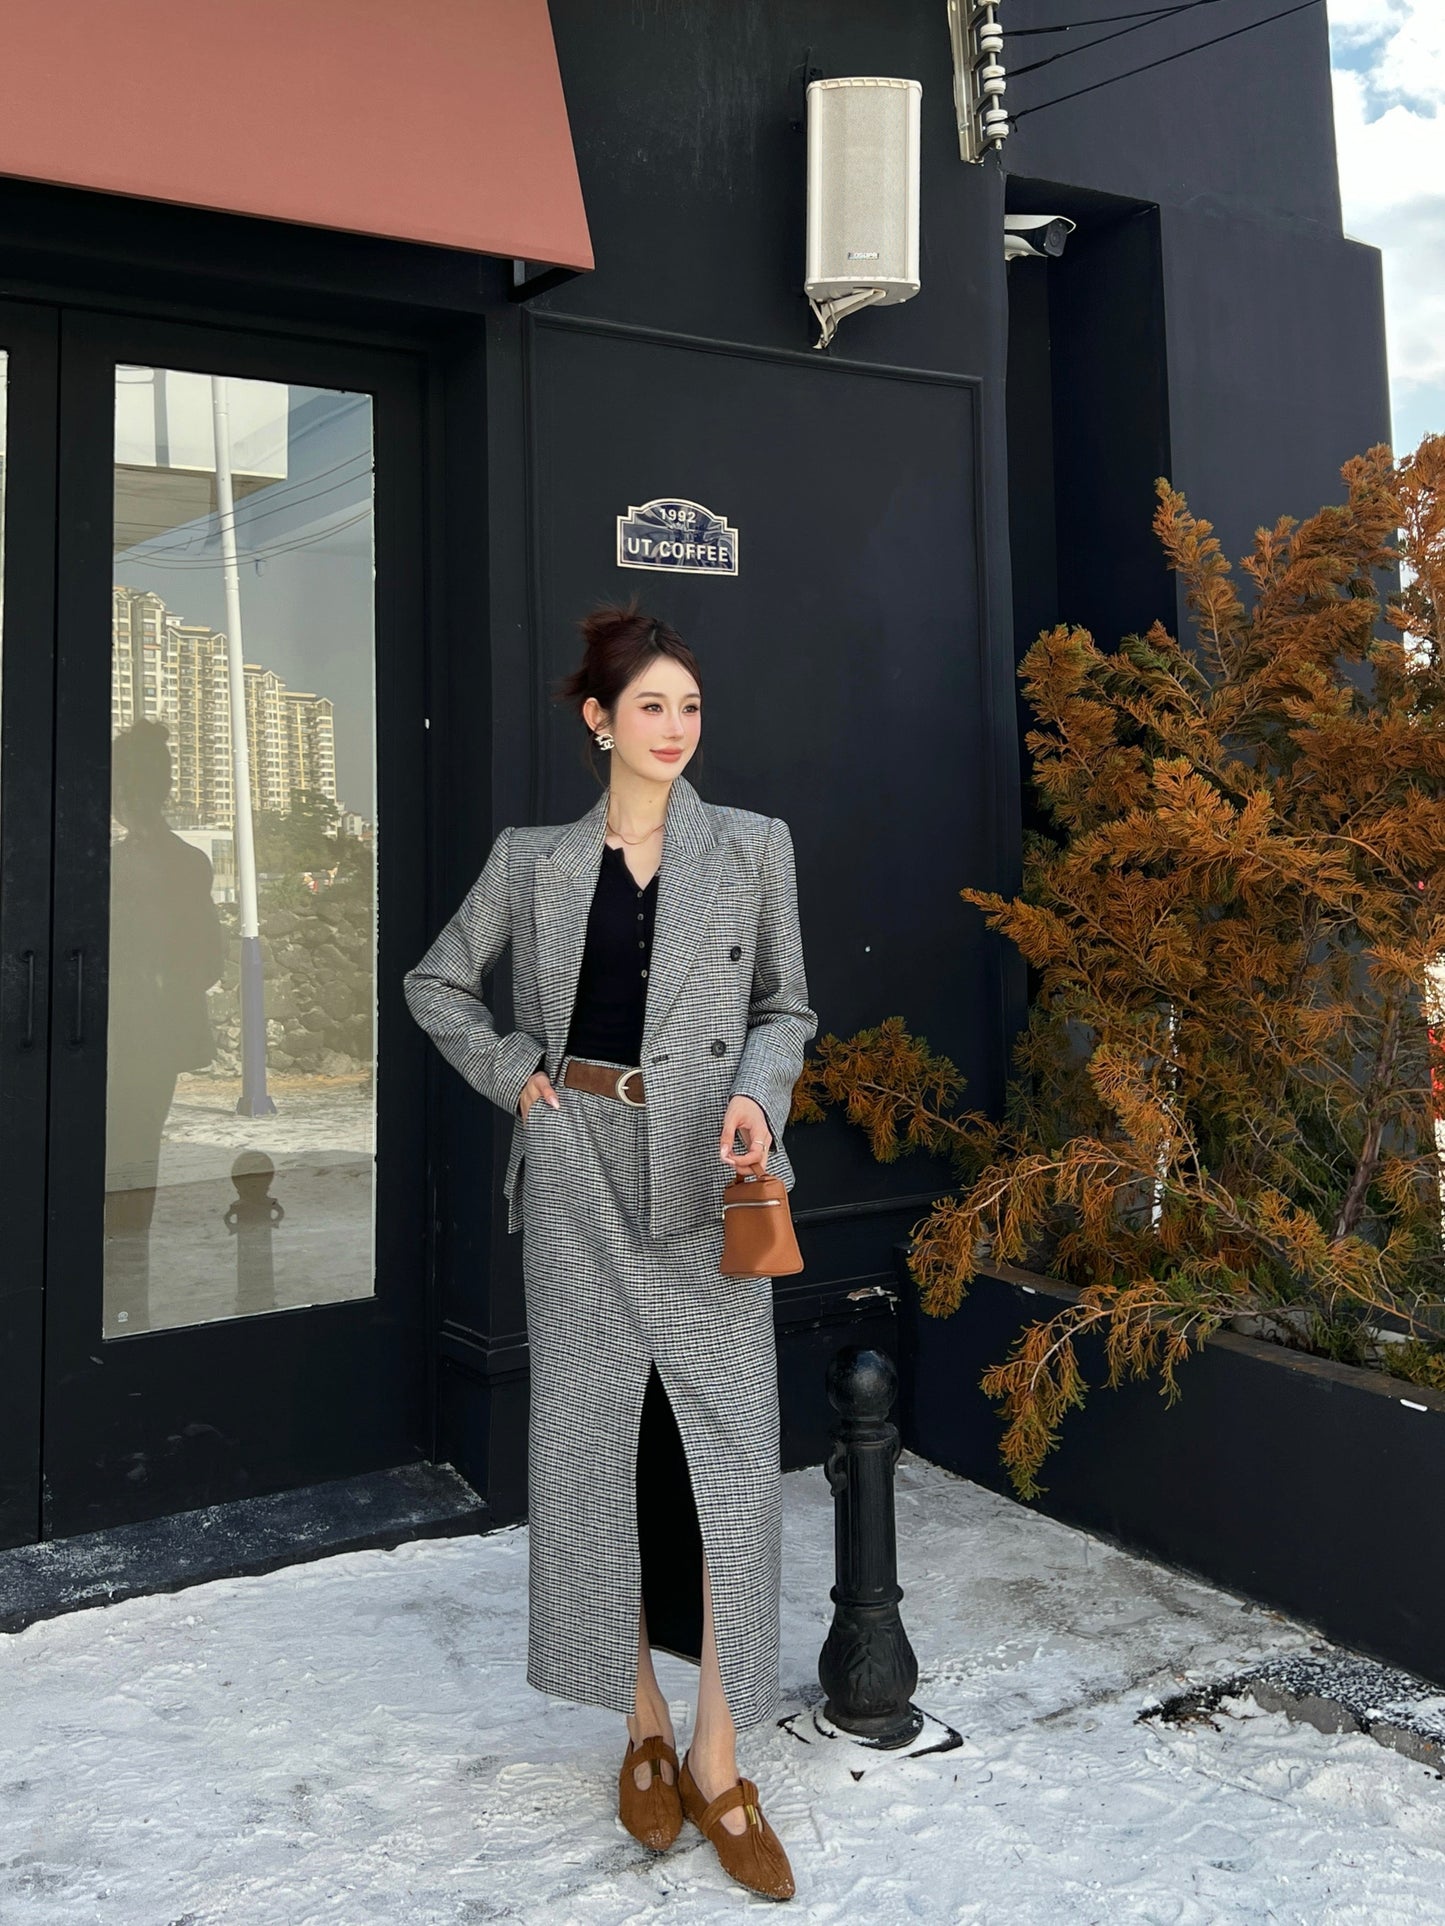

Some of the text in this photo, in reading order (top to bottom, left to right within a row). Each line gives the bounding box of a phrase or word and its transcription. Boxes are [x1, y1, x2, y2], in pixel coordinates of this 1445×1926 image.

[659, 508, 697, 523] 1992
[627, 537, 729, 562] UT COFFEE
